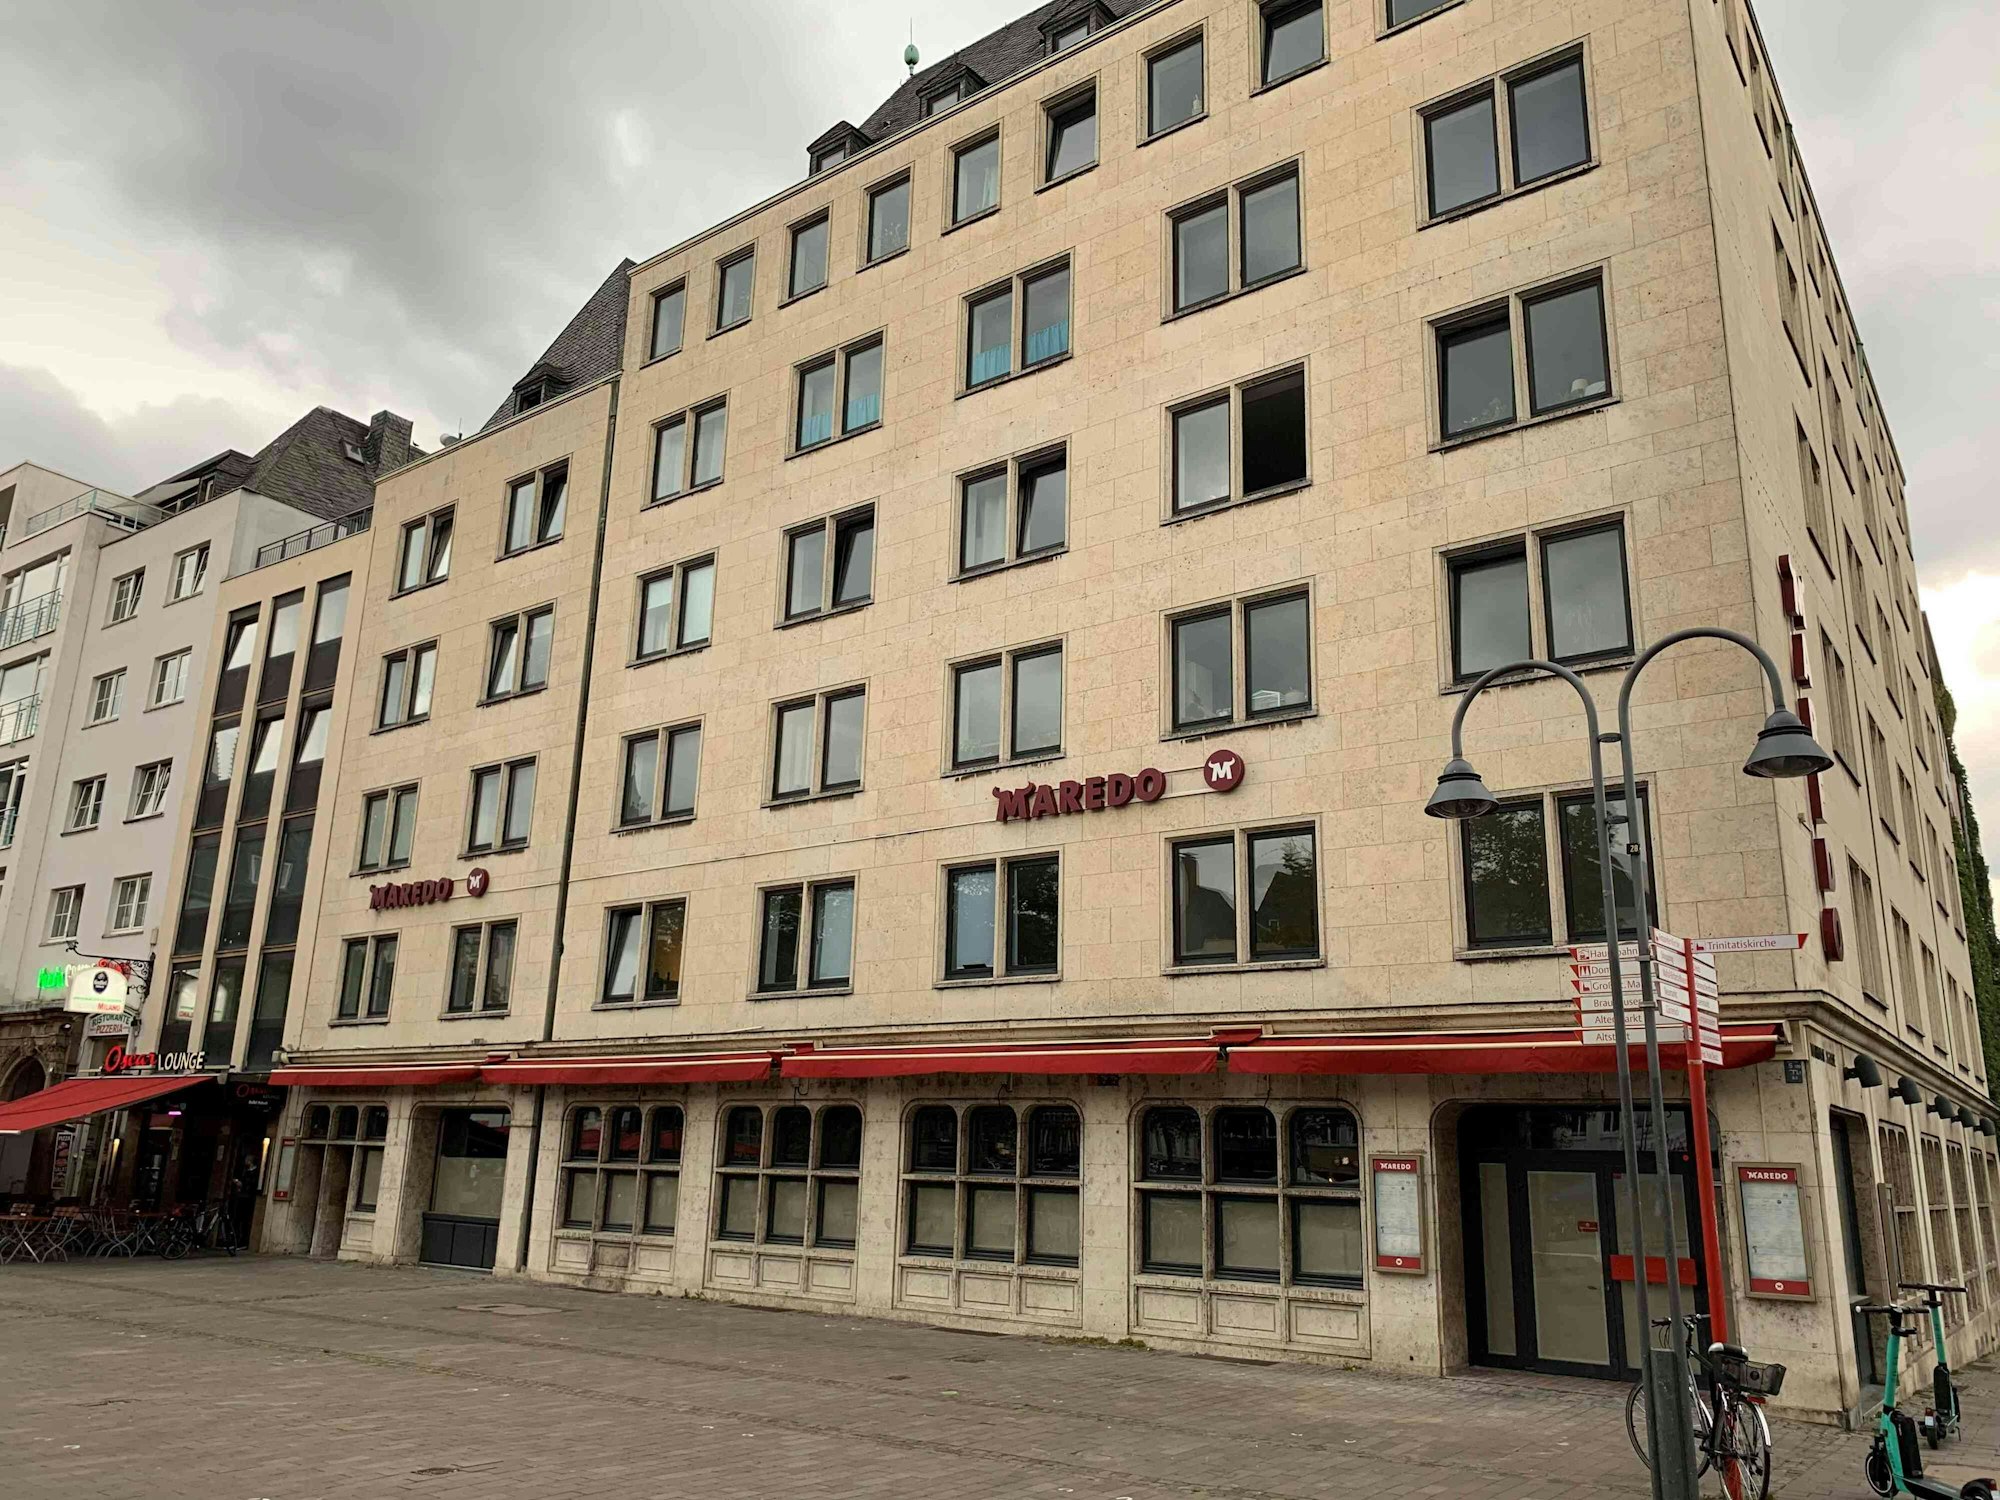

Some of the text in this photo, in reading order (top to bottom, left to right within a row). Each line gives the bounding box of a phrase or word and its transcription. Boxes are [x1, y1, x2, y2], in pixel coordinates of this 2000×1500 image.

[992, 767, 1167, 823] MAREDO
[369, 877, 455, 910] MAREDO
[1708, 936, 1777, 951] Trinitatiskirche
[1593, 999, 1642, 1008] Brauuser
[95, 1023, 123, 1034] PIZZERIA
[1596, 1032, 1631, 1042] Altstt
[158, 1051, 206, 1071] LOUNGE
[1380, 1162, 1412, 1170] MAREDO
[1747, 1171, 1788, 1180] MAREDO
